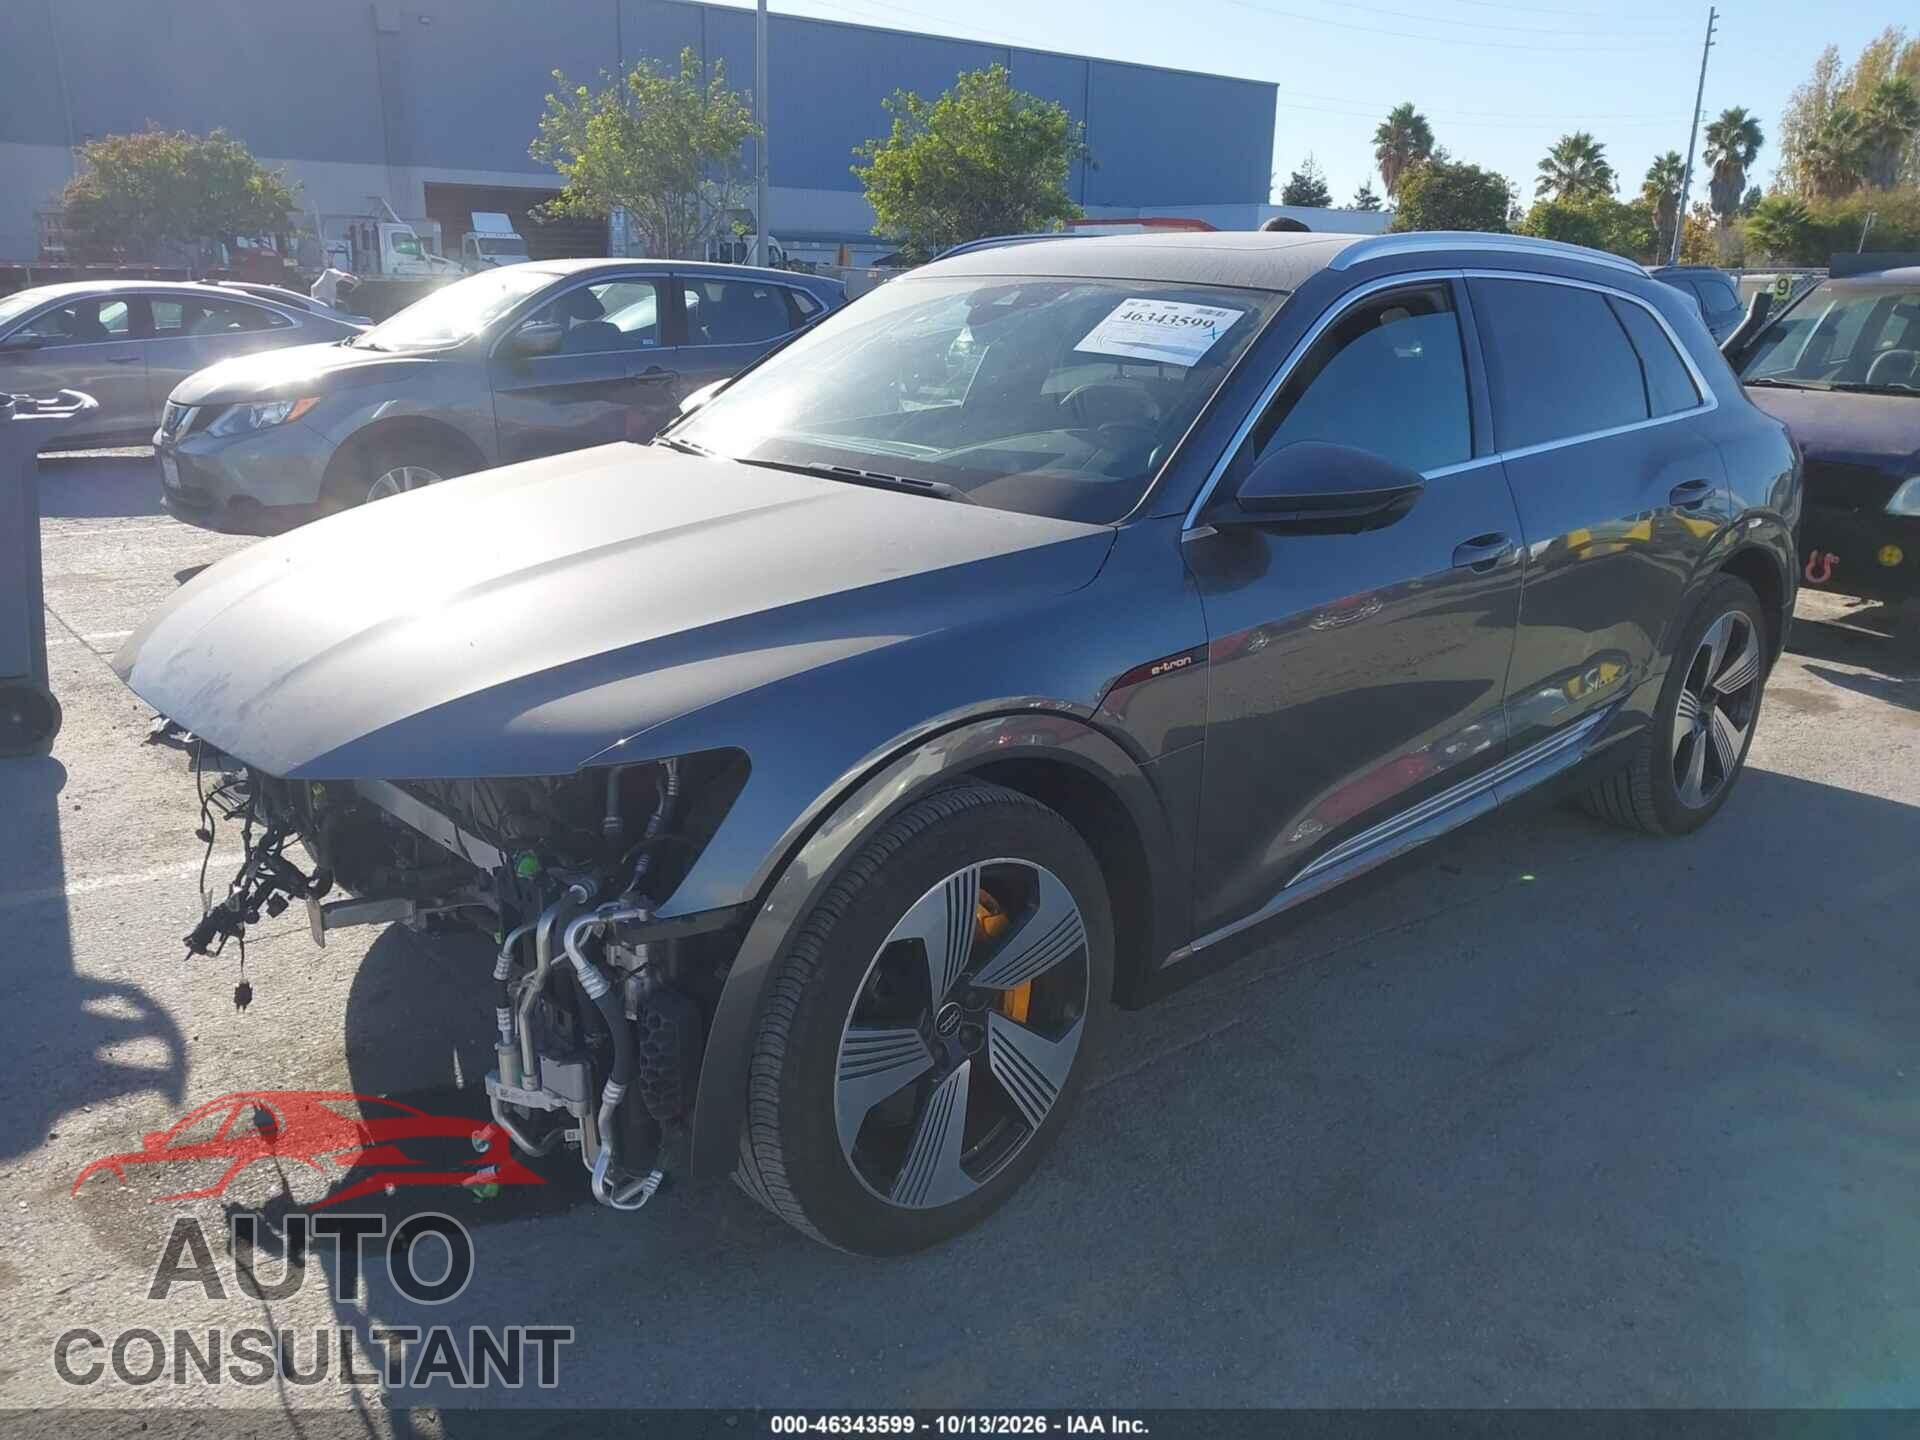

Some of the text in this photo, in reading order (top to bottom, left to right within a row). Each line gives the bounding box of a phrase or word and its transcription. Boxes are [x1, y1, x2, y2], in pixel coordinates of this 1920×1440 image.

[1777, 278, 1790, 296] 9
[1120, 310, 1216, 329] 46343599
[1151, 655, 1192, 675] e-tron
